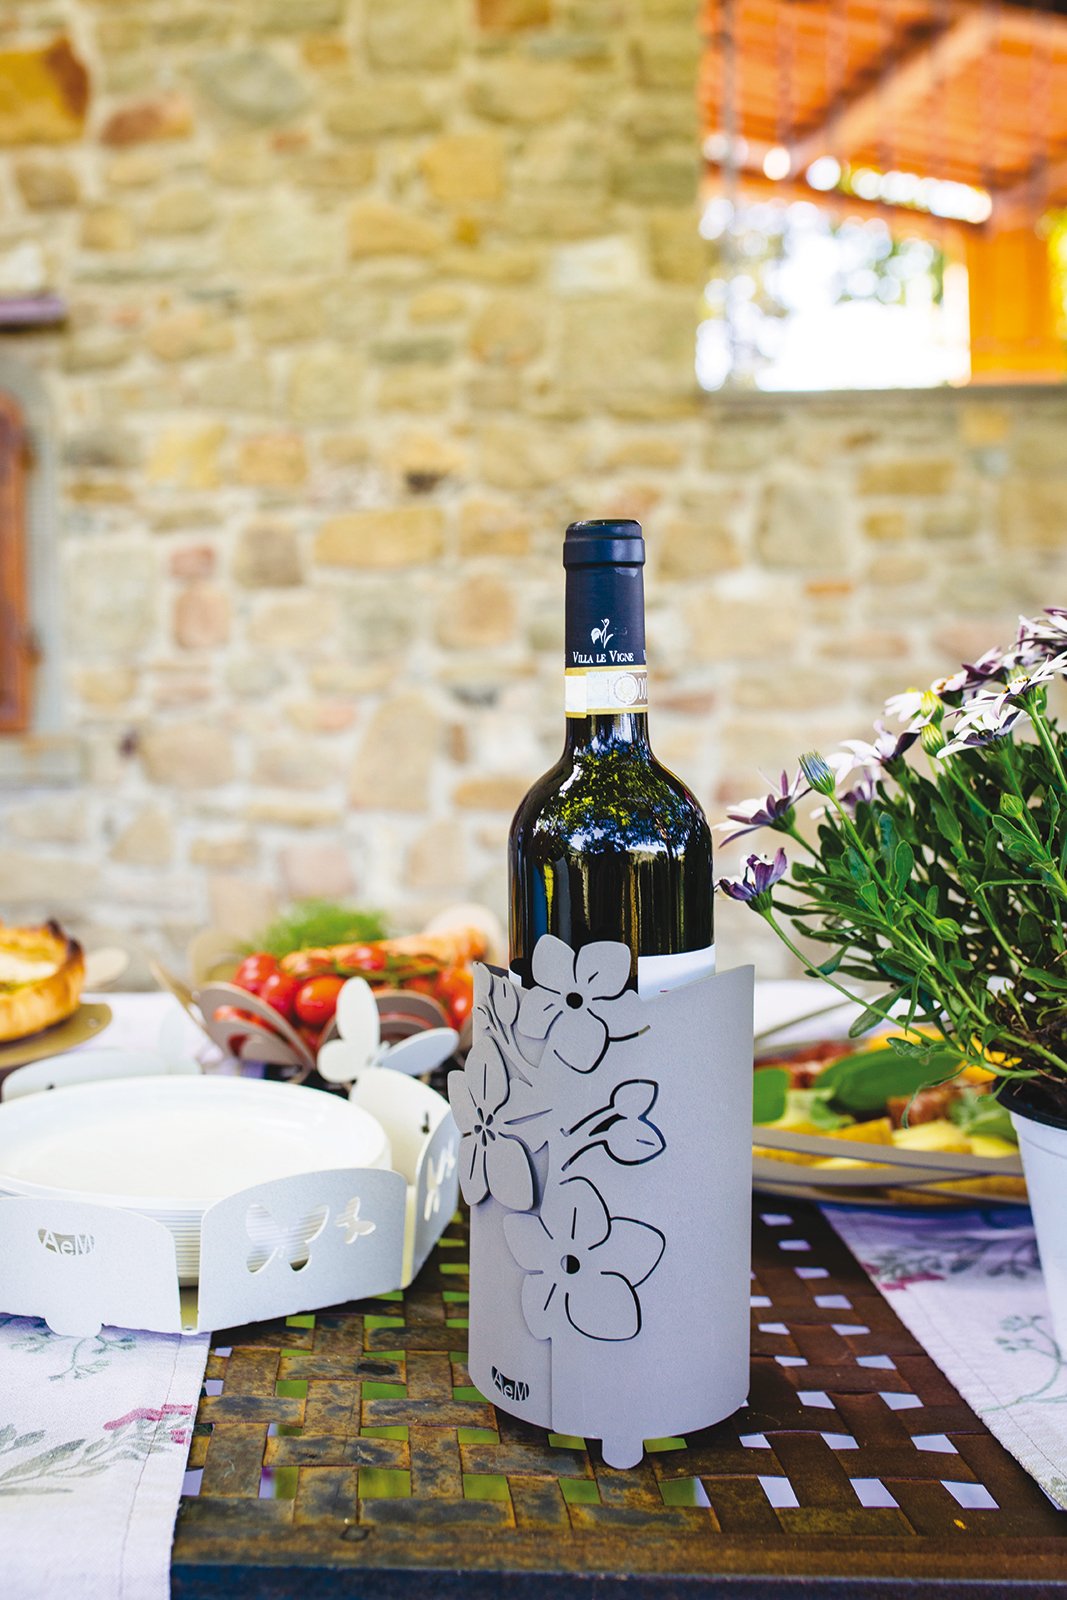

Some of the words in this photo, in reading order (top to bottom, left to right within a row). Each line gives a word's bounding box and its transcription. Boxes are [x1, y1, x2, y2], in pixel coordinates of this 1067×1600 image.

[572, 651, 594, 664] VILLA
[596, 653, 607, 663] LE
[609, 650, 634, 663] VIGNE
[38, 1229, 96, 1256] AeM
[492, 1366, 529, 1401] AeM
